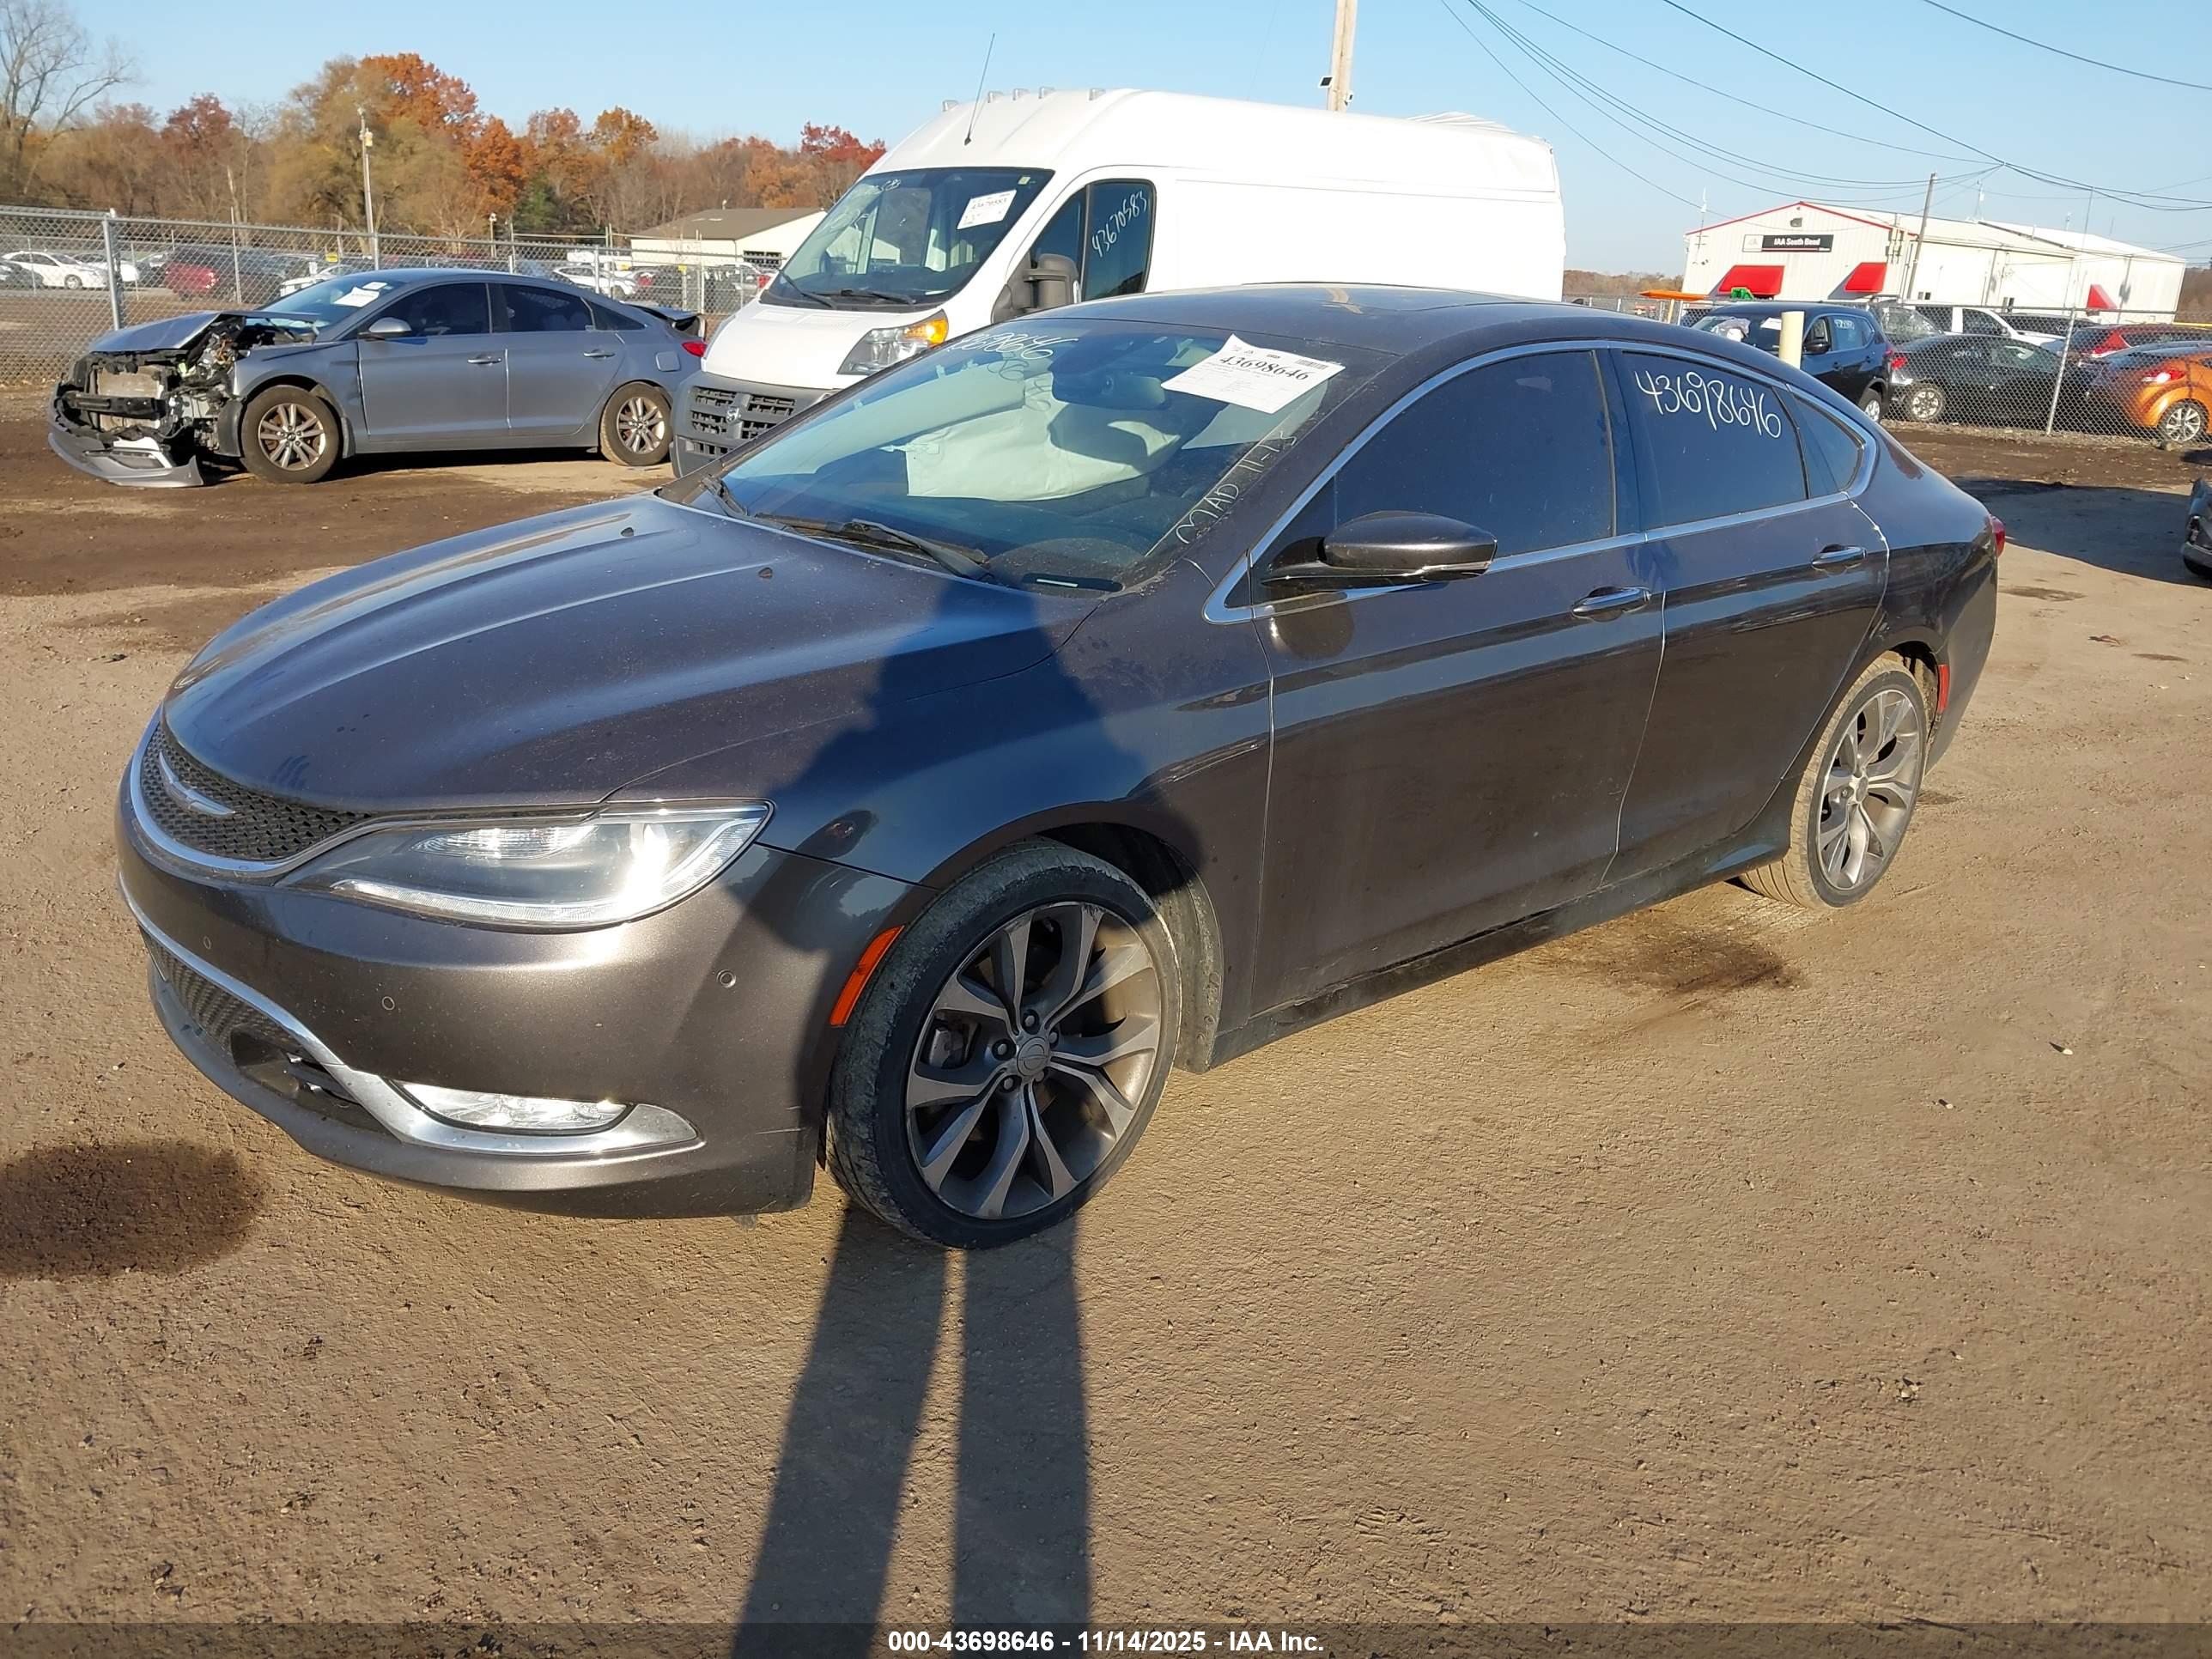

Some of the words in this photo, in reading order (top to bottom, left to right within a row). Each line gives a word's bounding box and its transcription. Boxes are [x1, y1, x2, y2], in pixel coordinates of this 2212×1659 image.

[1091, 190, 1147, 258] 43670583
[1219, 355, 1316, 380] 43698646
[1634, 370, 1782, 439] 43698646
[1176, 483, 1239, 544] MAD
